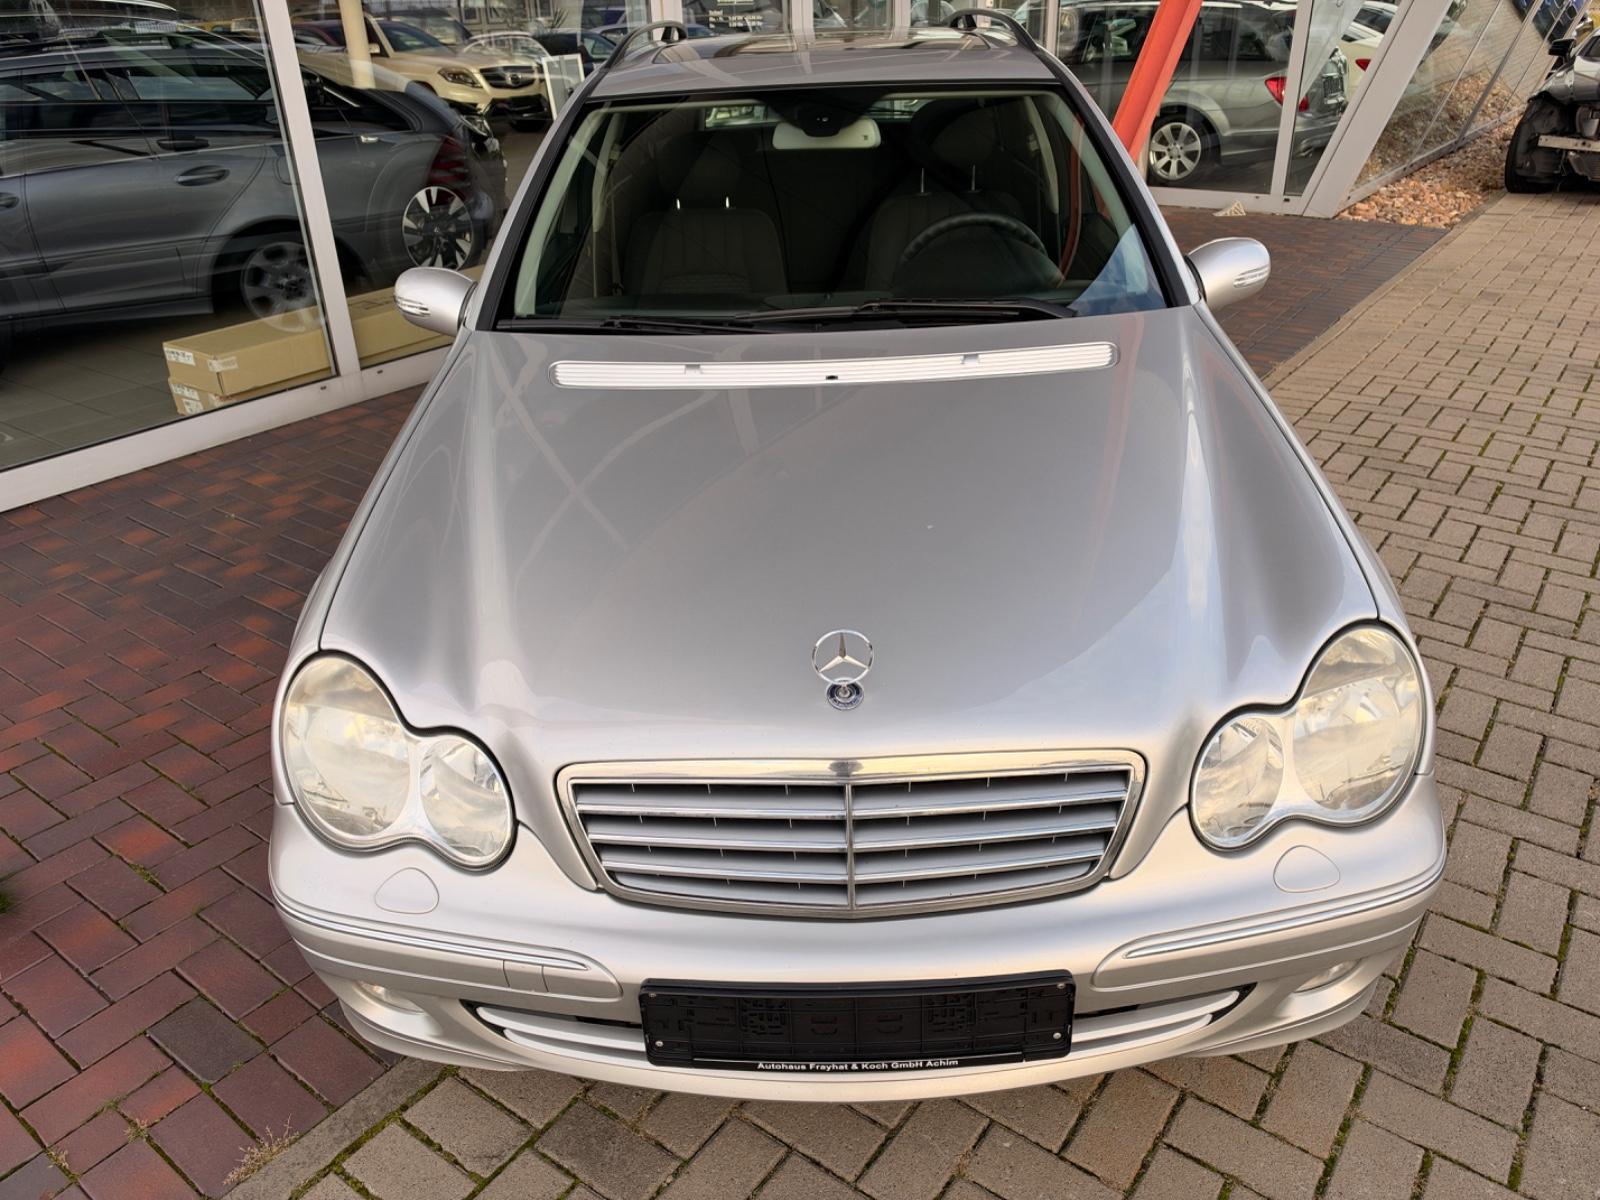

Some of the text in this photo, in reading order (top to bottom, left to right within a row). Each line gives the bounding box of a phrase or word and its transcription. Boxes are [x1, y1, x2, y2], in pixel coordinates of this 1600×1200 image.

[861, 1062, 888, 1070] Koch
[891, 1061, 922, 1069] GmbH
[926, 1059, 958, 1067] Achim
